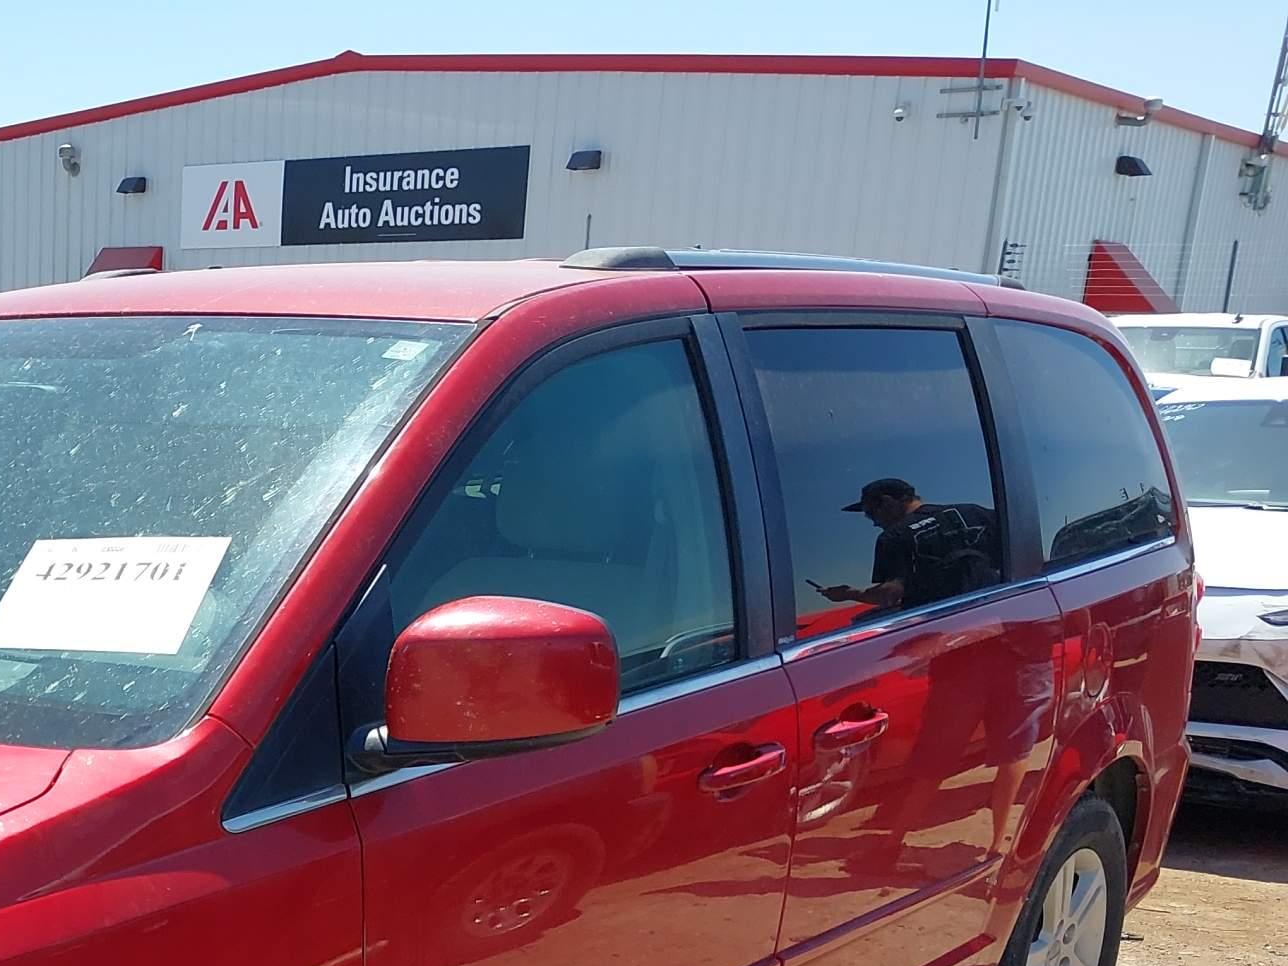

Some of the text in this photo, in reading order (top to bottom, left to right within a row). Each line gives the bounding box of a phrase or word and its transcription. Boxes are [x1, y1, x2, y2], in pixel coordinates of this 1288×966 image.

[344, 166, 459, 193] Insurance
[318, 197, 481, 229] Auto Auctions
[36, 562, 187, 581] 42921701
